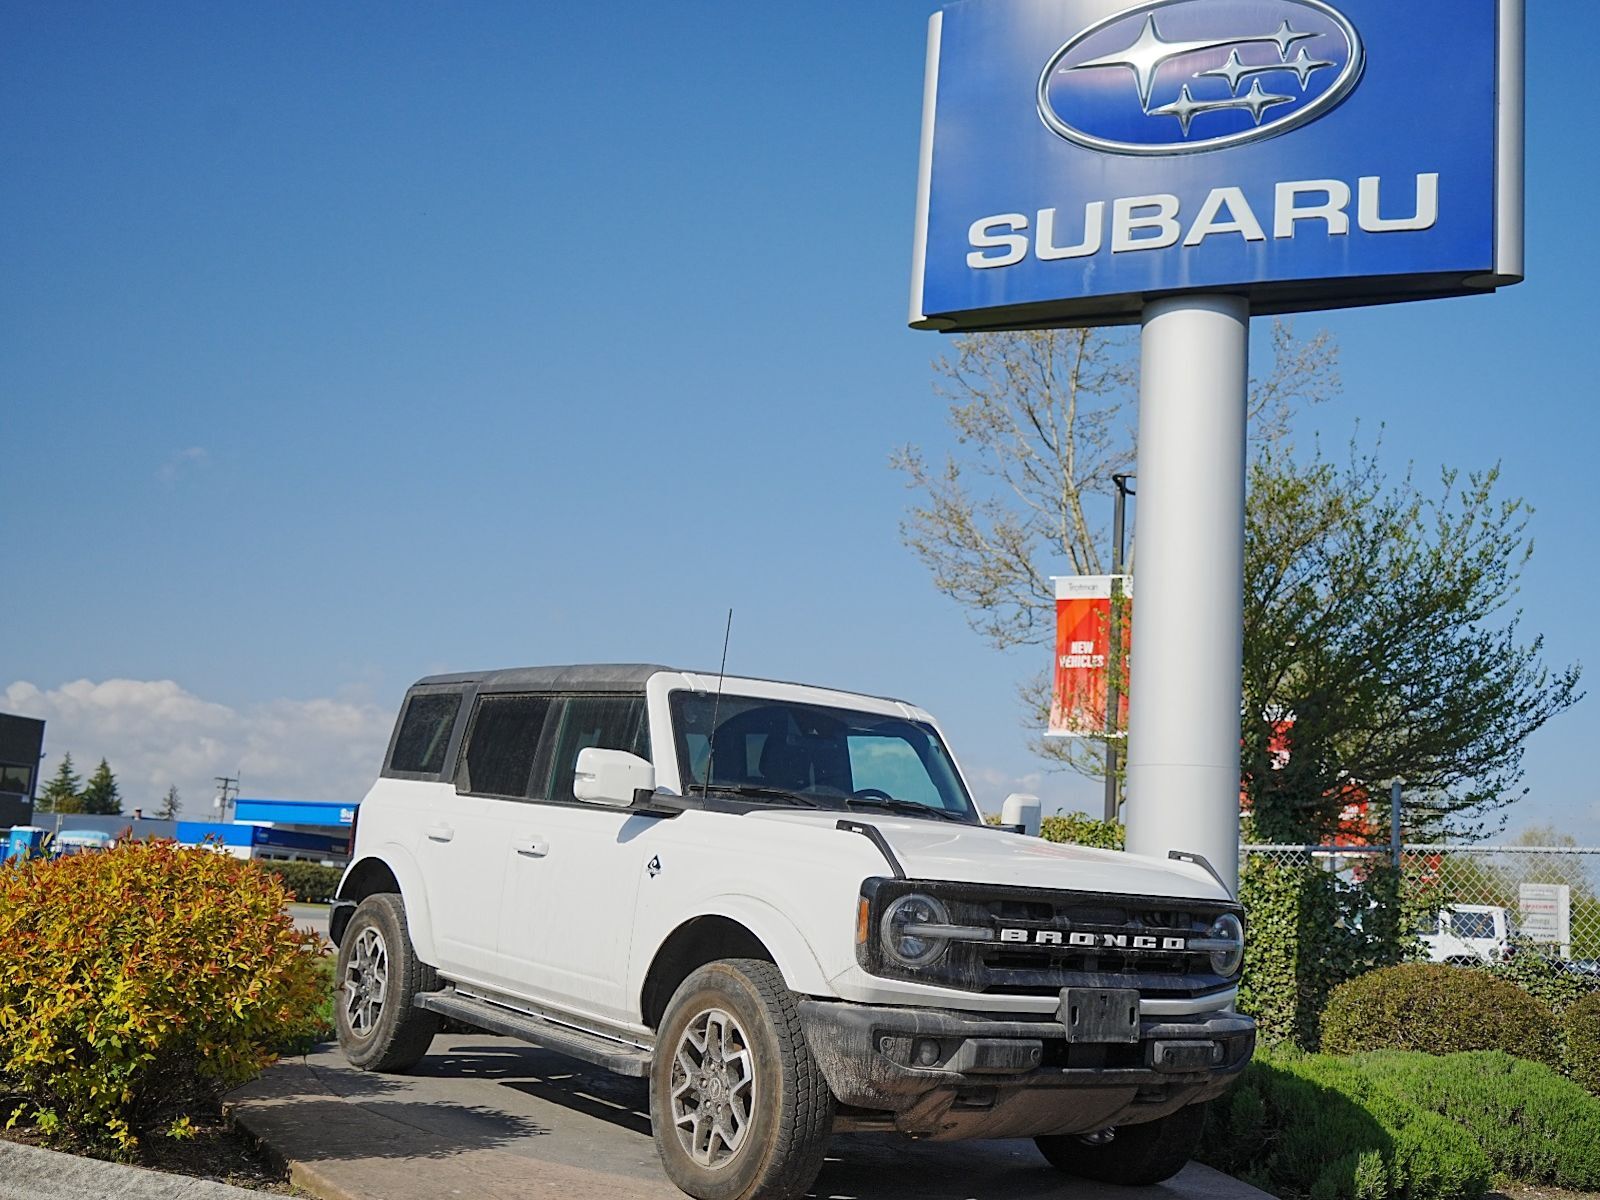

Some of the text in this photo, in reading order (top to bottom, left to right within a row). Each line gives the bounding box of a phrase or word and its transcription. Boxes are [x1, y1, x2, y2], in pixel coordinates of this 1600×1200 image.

[966, 173, 1439, 269] SUBARU
[1071, 641, 1094, 655] NEW
[1059, 655, 1105, 669] VEHICLES
[1000, 928, 1185, 950] BRONCO
